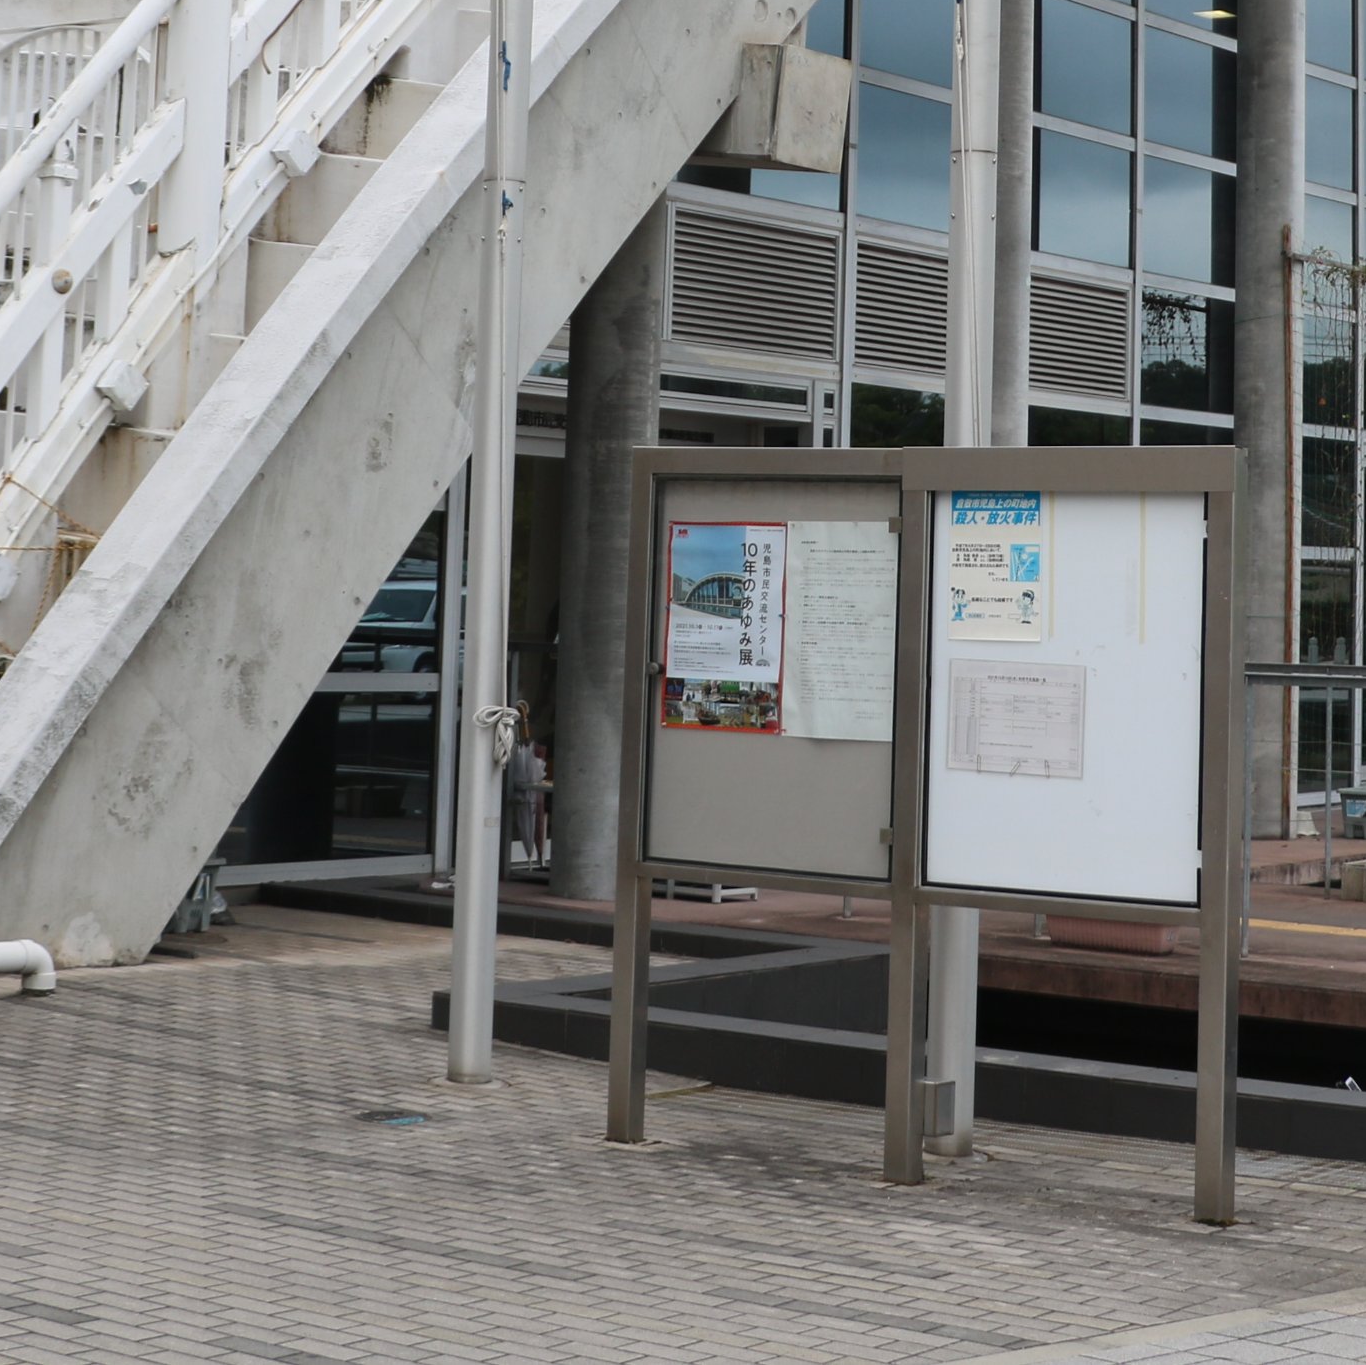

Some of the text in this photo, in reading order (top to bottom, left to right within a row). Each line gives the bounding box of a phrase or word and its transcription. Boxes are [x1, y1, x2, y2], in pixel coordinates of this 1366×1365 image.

[955, 511, 1038, 526] 殺人・放火事件
[738, 542, 758, 667] 10年のあゆみ展
[758, 542, 772, 656] 児島市民交流センター
